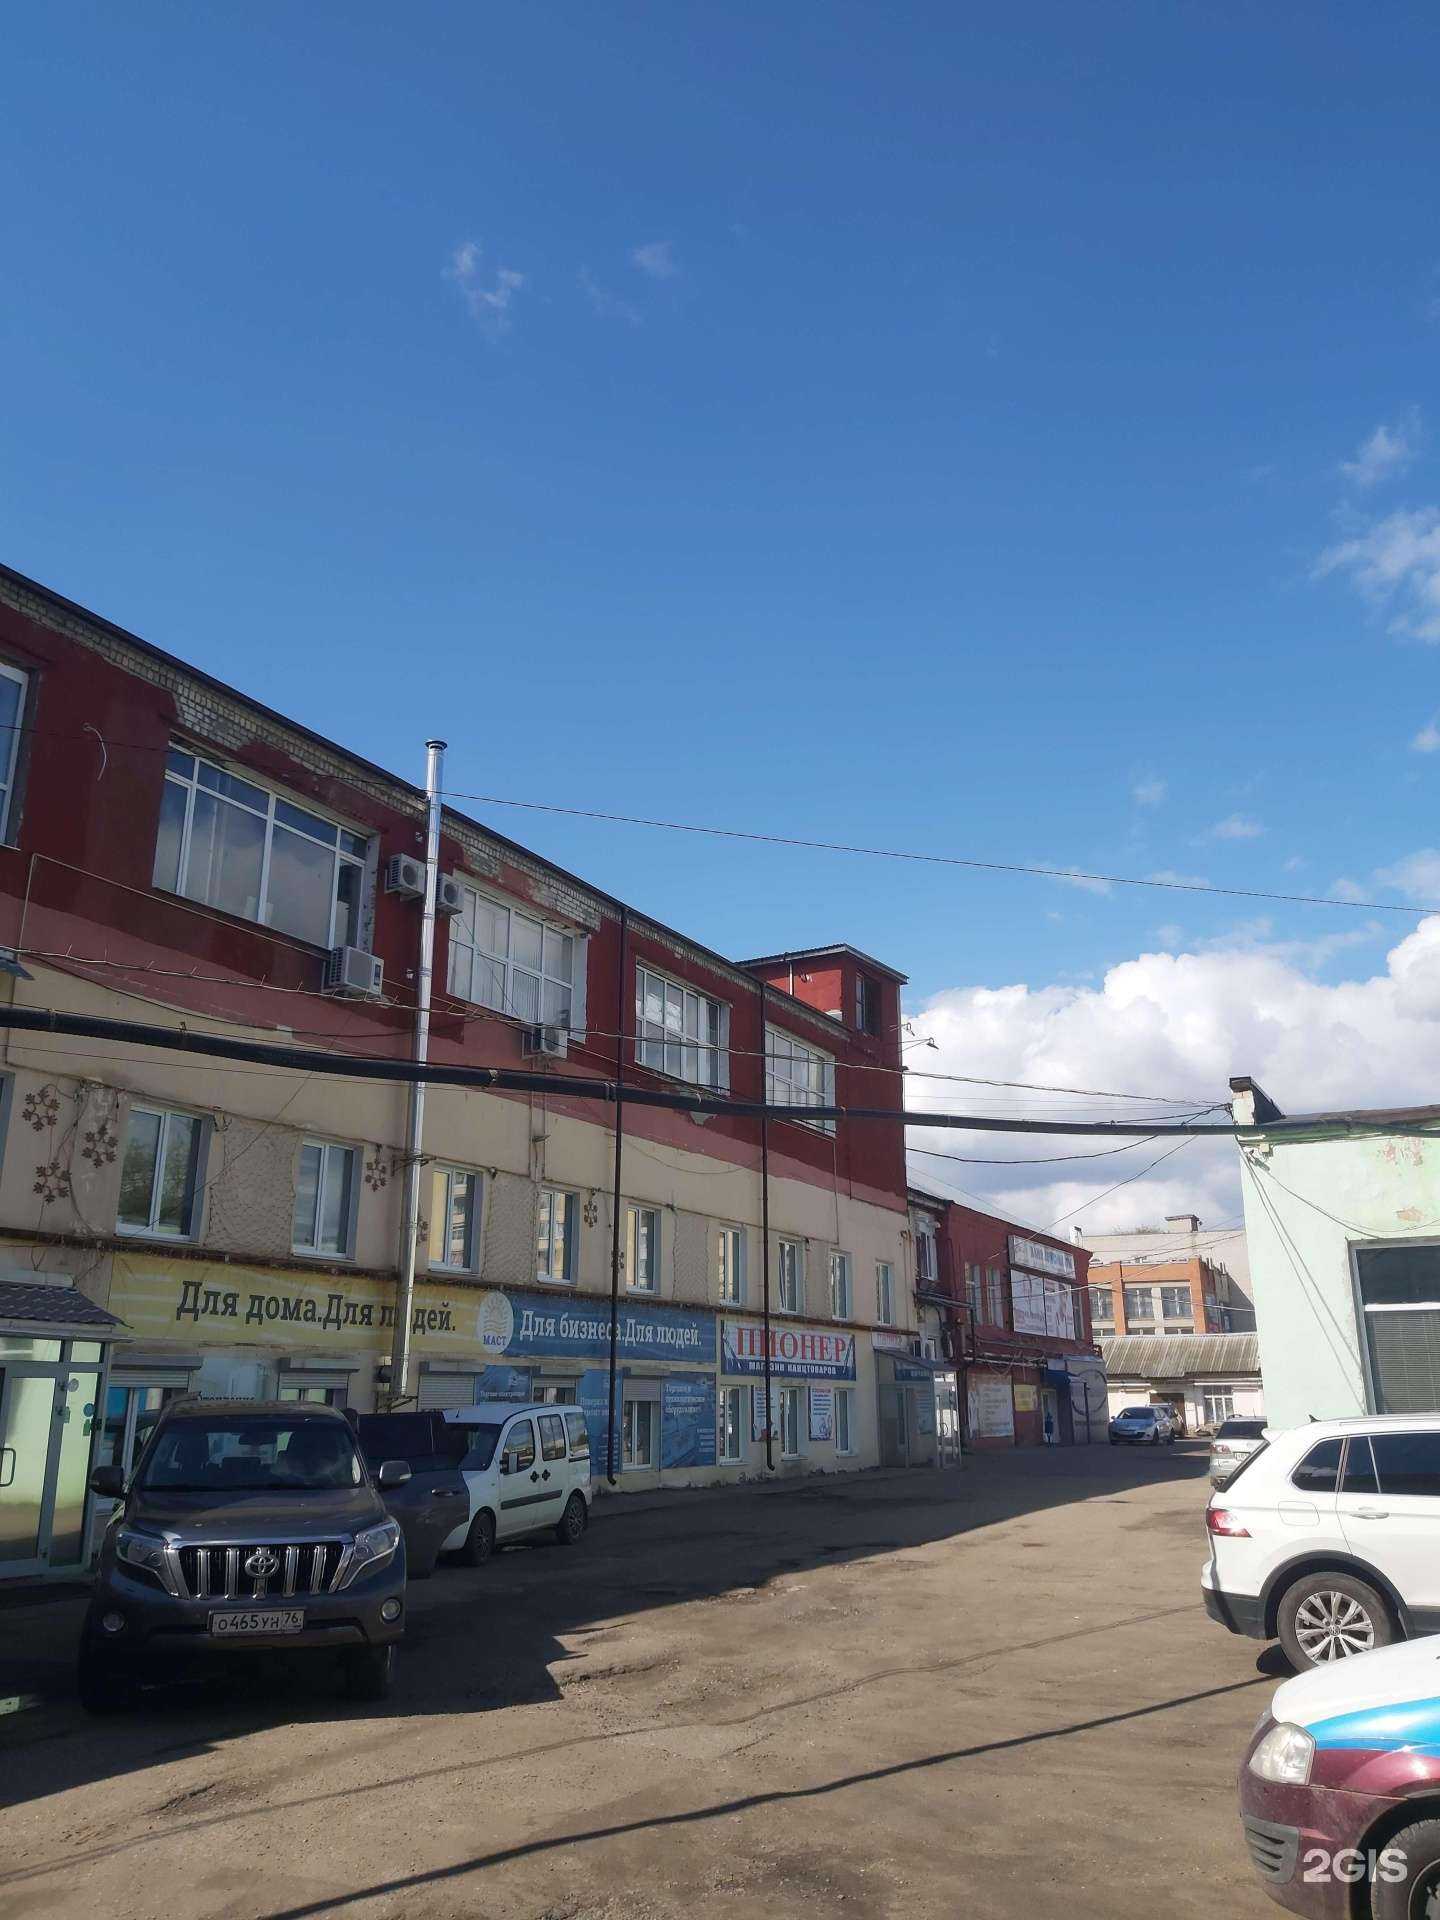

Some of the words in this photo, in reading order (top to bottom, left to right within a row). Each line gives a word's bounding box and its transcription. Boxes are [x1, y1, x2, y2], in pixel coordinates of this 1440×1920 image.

[176, 1280, 240, 1321] Для
[379, 1302, 456, 1334] лдей.
[482, 1335, 508, 1347] МАСТ
[519, 1310, 556, 1341] Для
[656, 1323, 702, 1349] людей.
[736, 1327, 847, 1362] ПИОНЕР
[748, 1361, 785, 1372] МАГЗИН
